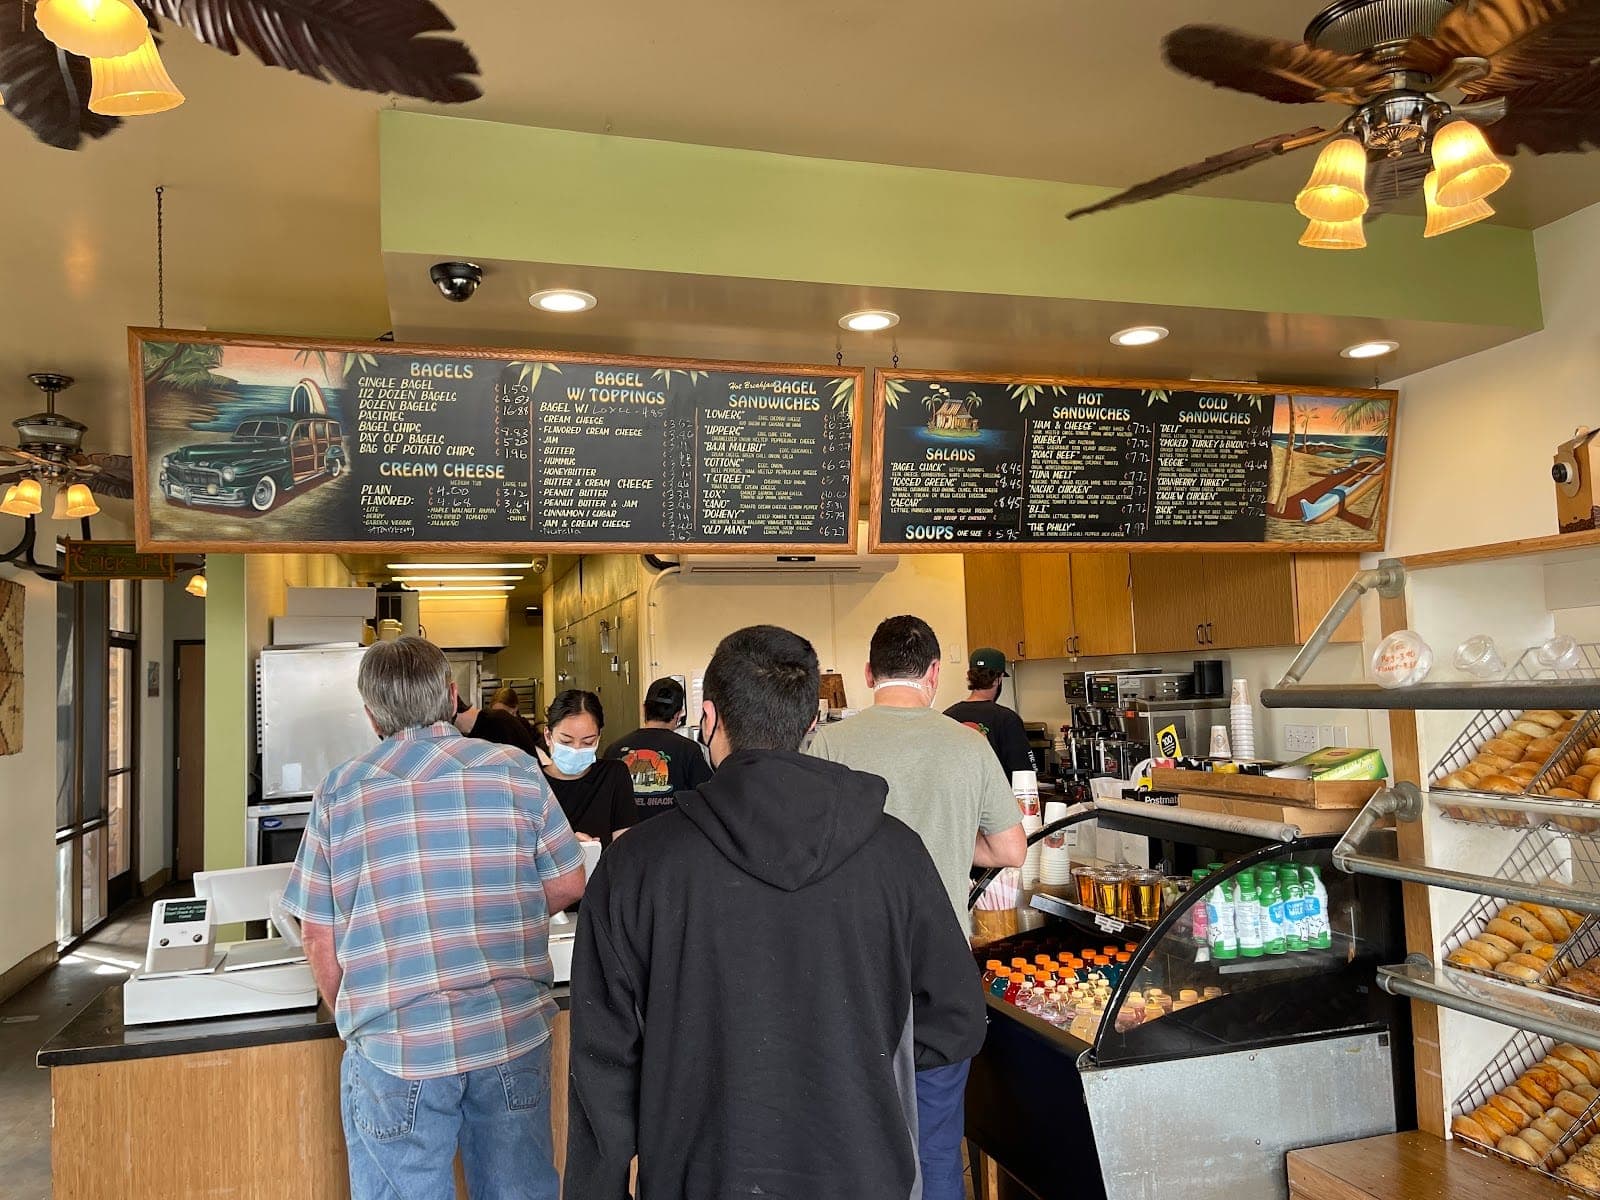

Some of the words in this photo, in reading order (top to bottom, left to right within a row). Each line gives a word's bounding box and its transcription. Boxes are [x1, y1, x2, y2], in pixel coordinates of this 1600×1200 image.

[410, 362, 474, 379] BAGELS
[358, 376, 397, 389] SINGLE
[400, 378, 434, 390] BAGEL
[595, 371, 644, 387] BAGEL
[728, 382, 742, 390] Hot
[744, 381, 775, 391] Breakfas
[774, 380, 816, 395] BAGEL
[378, 389, 417, 400] DOZEN
[421, 390, 457, 402] BAGELS
[567, 387, 585, 401] W/
[588, 387, 665, 404] TOPPINGS
[1077, 392, 1104, 405] HOT
[359, 400, 396, 411] DOZEN
[400, 400, 437, 412] BAGELS
[540, 402, 571, 413] BAGEL
[575, 404, 589, 414] W/
[729, 394, 821, 411] SANDWICHES
[1199, 397, 1228, 410] COLD
[358, 410, 405, 422] PASTRIES
[1052, 406, 1131, 420] SANDWICHES
[1178, 411, 1251, 424] SANDWICHES
[544, 415, 571, 424] CREAM
[575, 416, 604, 425] CHEESE
[1055, 421, 1060, 429] &
[358, 422, 389, 432] BAGEL
[393, 422, 422, 433] CHIPS
[544, 426, 581, 435] FLAVORED
[586, 428, 610, 436] CREAM
[615, 428, 643, 437] CHEESE
[360, 433, 379, 443] DAY
[383, 434, 404, 444] OLD
[409, 434, 444, 445] BAGELS
[543, 436, 559, 444] JAM
[1192, 439, 1219, 448] TURKEY
[1220, 440, 1225, 448] &
[359, 444, 378, 454] BAG
[384, 444, 398, 454] OF
[402, 445, 441, 455] POTATO
[446, 446, 475, 456] CHIPS
[544, 446, 575, 455] BUTTER
[926, 447, 976, 461] SALADS
[543, 457, 576, 465] HUMMUS
[380, 462, 438, 477] CREAM
[443, 463, 505, 479] CHEESE
[543, 468, 597, 476] HONEYBUTTER
[543, 478, 573, 486] BUTTER
[585, 479, 610, 487] CREAM
[617, 479, 654, 489] CHEESE
[361, 485, 392, 495] PLAIN
[543, 489, 574, 497] PEANUT
[579, 489, 608, 497] BUTTER
[361, 496, 415, 506] FLAVORED:
[543, 499, 574, 507] PEANUT
[622, 500, 638, 508] JAM
[543, 519, 558, 528] JAM
[562, 520, 568, 528] &
[571, 520, 598, 528] CREAM
[602, 520, 632, 528] CHEESE
[905, 525, 954, 540] SOUPS
